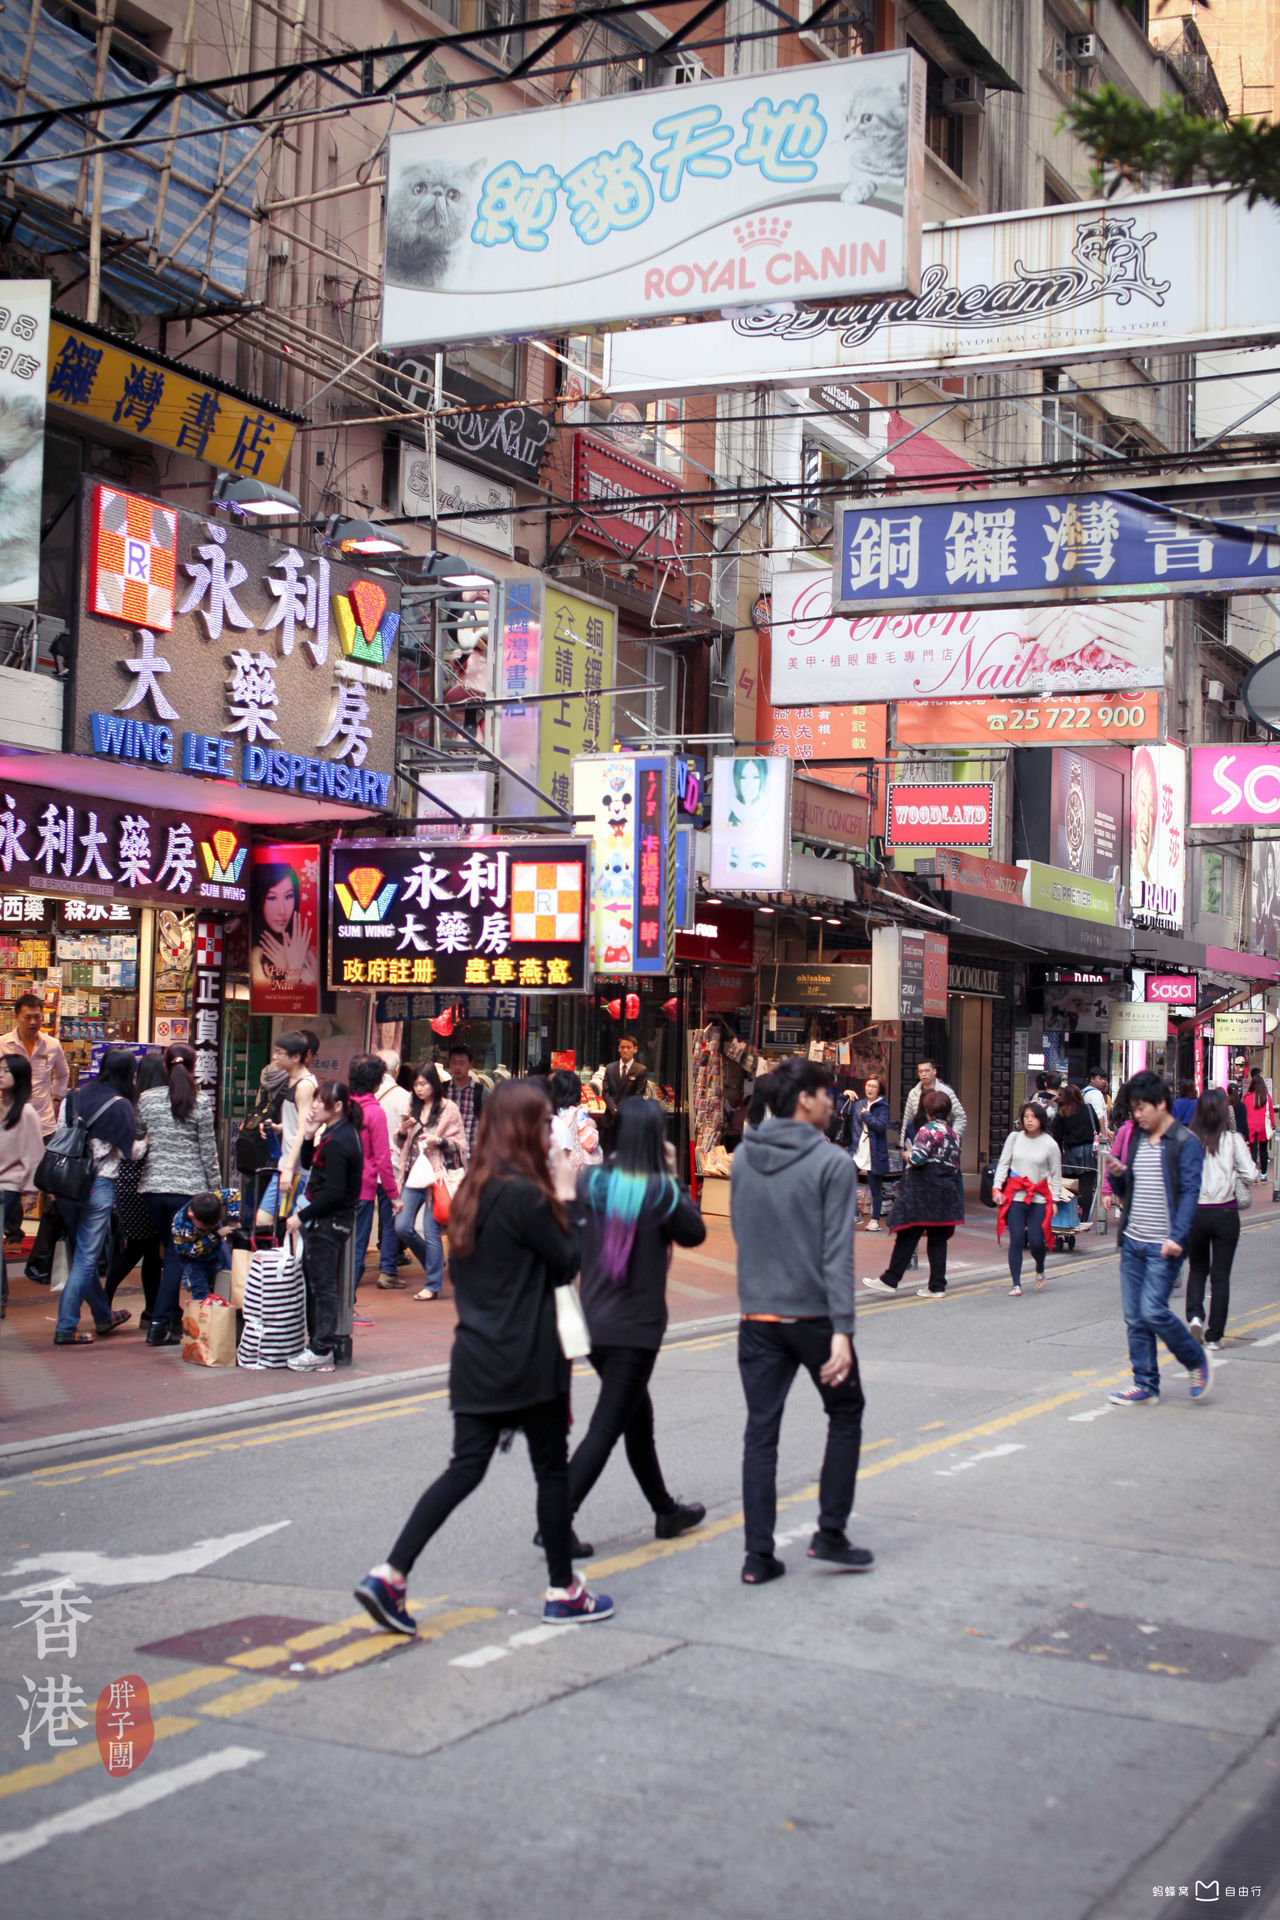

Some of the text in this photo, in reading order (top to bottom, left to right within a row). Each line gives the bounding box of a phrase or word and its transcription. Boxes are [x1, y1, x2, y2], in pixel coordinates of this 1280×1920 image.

[471, 93, 828, 251] 純貓天地
[644, 239, 888, 300] ROYAL CANIN
[945, 319, 1169, 347] DAYDREAM CLOTHING STORE
[850, 500, 1280, 592] 銅鑼灣書
[175, 521, 331, 666] 永利
[913, 630, 1042, 694] Nail
[112, 628, 374, 767] 大藥房
[1009, 705, 1146, 729] 25 722 900
[91, 712, 393, 807] WING LEE DISPENSARY
[826, 808, 864, 835] CONCEPT
[893, 805, 988, 826] WOODLAND
[1162, 784, 1180, 869] 莎莎
[0, 793, 198, 894] 永利大藥房
[222, 885, 246, 901] WING
[400, 850, 511, 910] 永利
[0, 896, 45, 922] 西藥
[337, 922, 395, 938] SUM WING
[396, 910, 511, 955] 大藥房
[271, 979, 296, 991] Nail
[464, 957, 573, 986] 蟲草燕窩
